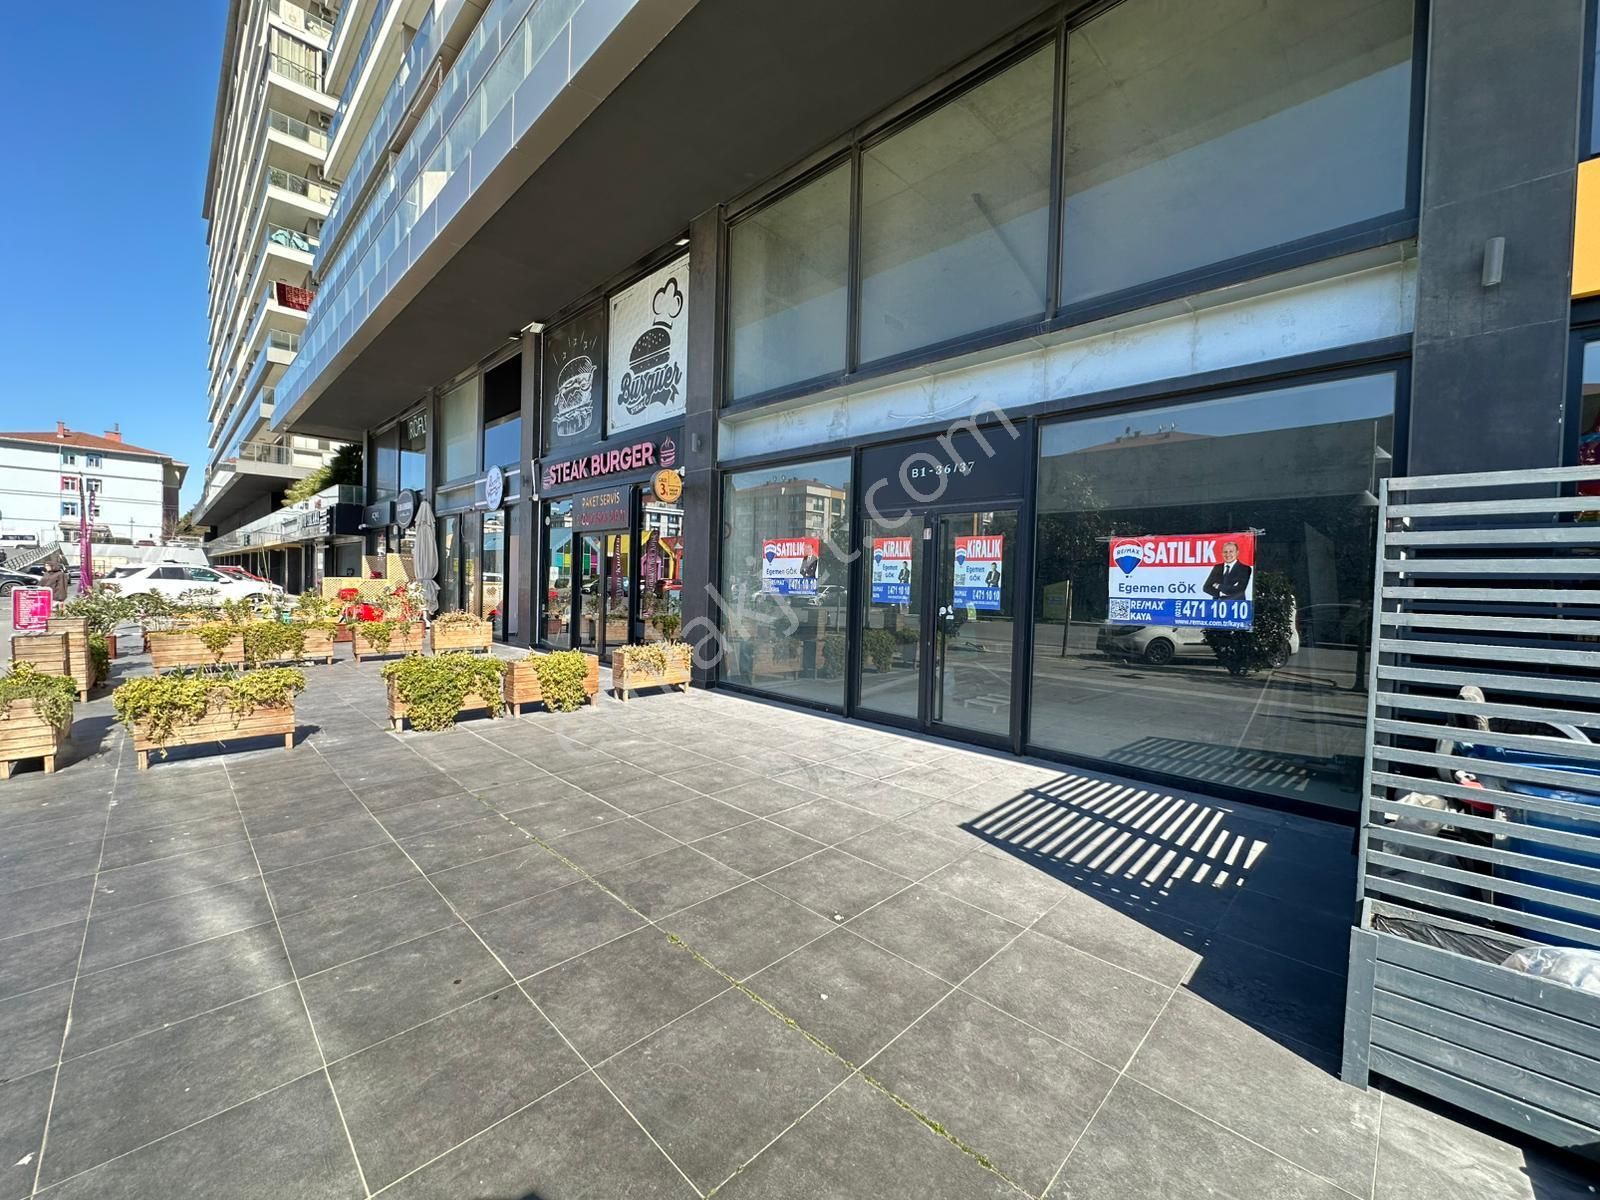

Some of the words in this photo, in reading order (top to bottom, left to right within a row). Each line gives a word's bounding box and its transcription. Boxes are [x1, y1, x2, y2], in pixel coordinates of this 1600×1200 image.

[549, 457, 588, 485] STEAK
[591, 442, 655, 477] BURGER
[581, 496, 599, 509] PAKET
[776, 541, 805, 557] SATILIK
[1116, 548, 1141, 557] RE/MAX
[1143, 540, 1217, 565] SATILIK
[766, 568, 784, 576] Egemen
[785, 567, 798, 576] GÖK
[1118, 583, 1164, 595] Egemen
[1168, 581, 1196, 595] GÖK
[1130, 600, 1165, 612] RE/MAX
[1182, 600, 1206, 618] 471
[1210, 601, 1227, 619] 10
[1231, 601, 1249, 620] 10
[1130, 612, 1153, 622] KAYA
